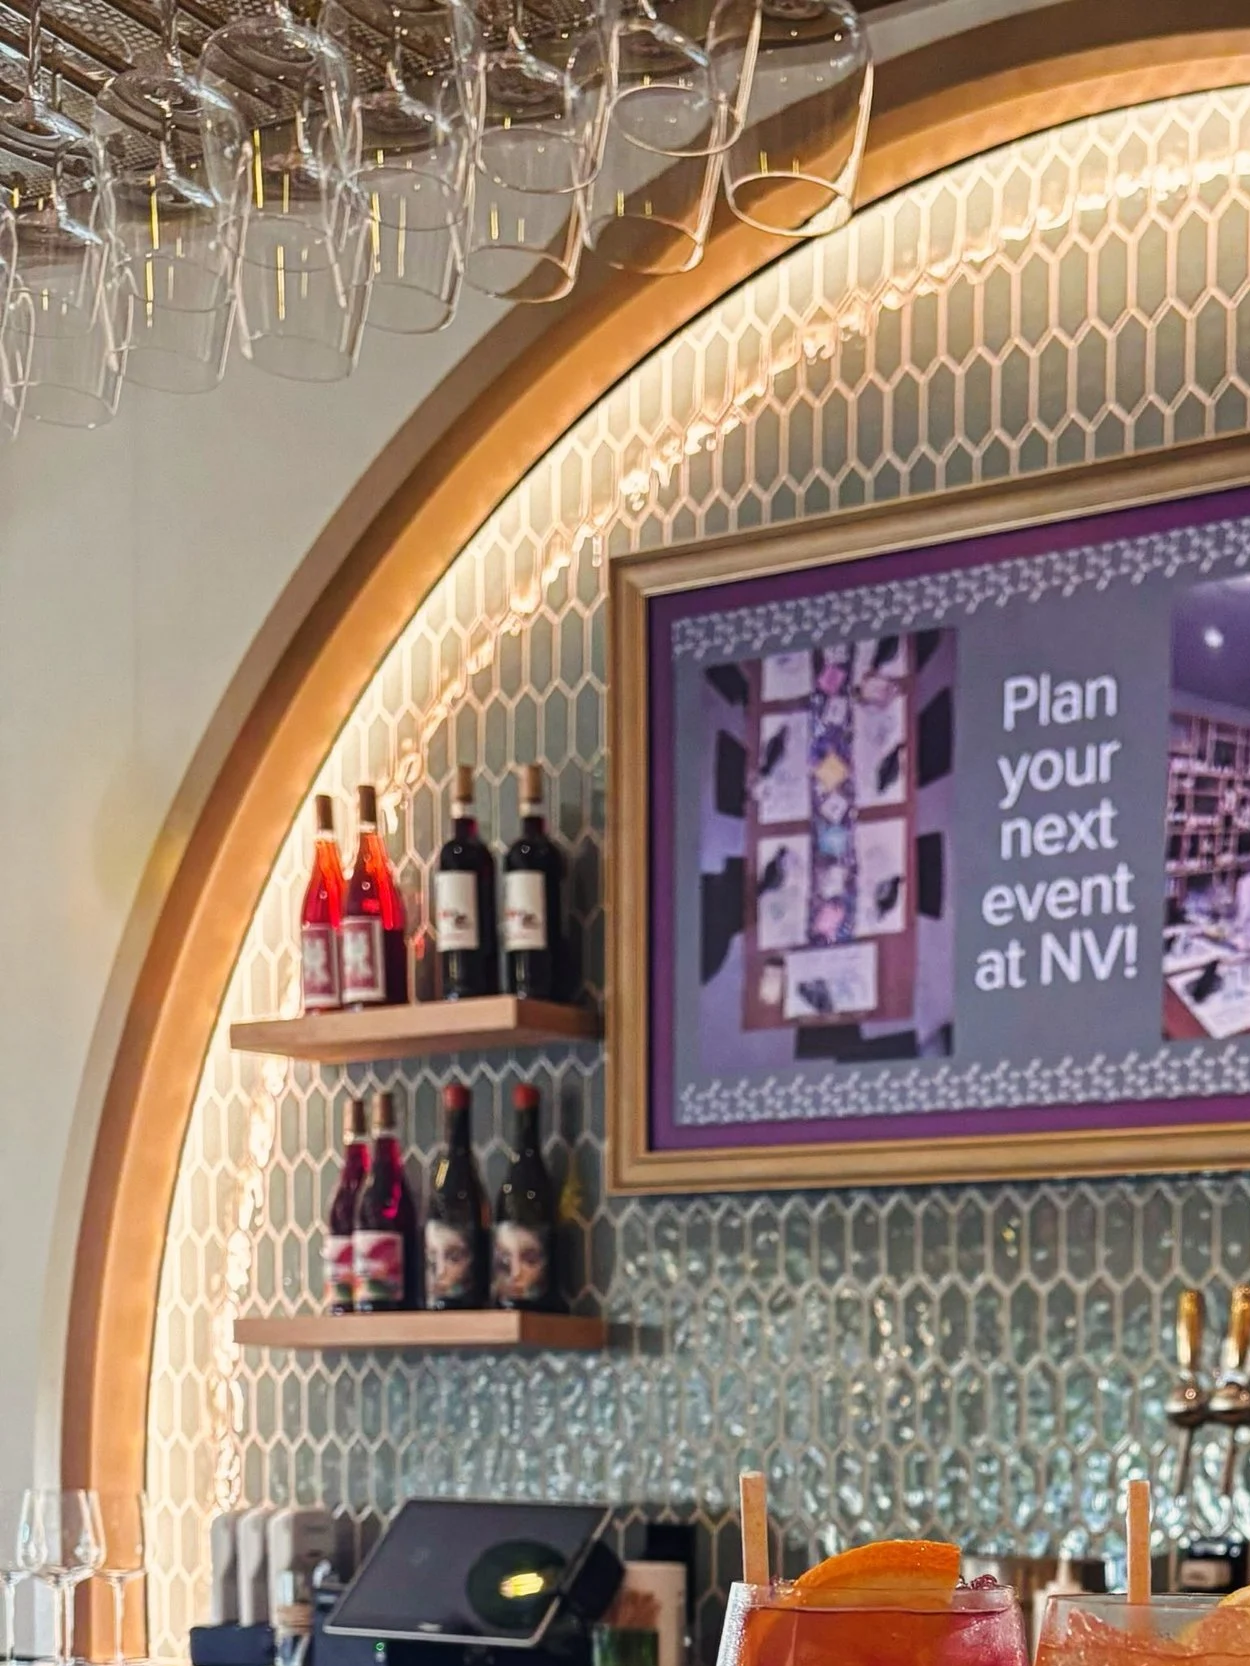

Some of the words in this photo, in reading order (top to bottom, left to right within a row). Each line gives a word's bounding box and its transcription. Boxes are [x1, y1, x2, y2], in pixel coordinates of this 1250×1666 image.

[1004, 672, 1118, 731] Plan
[998, 740, 1121, 809] your
[1001, 798, 1118, 860] next
[982, 862, 1134, 926] event
[975, 938, 1027, 991] at
[1040, 924, 1138, 986] NV!
